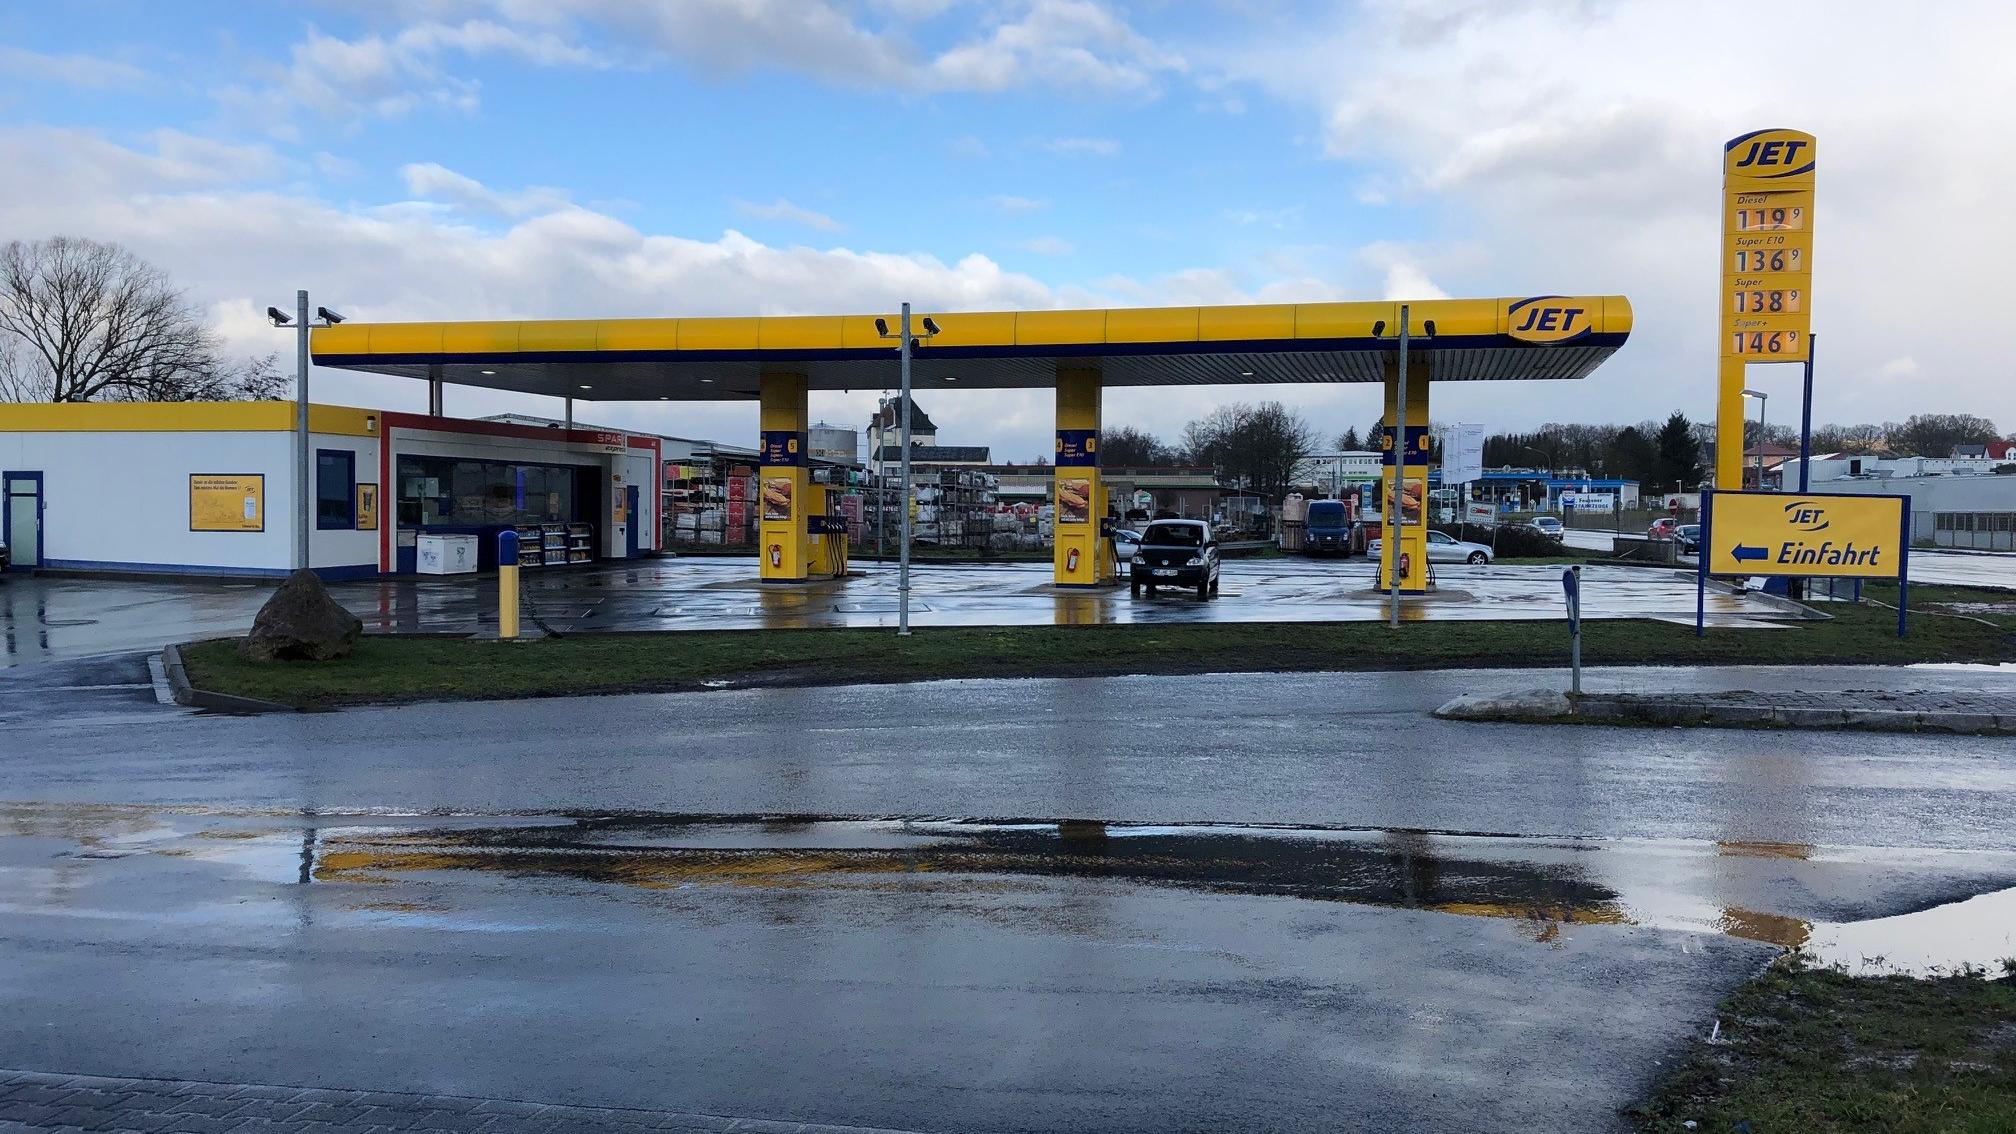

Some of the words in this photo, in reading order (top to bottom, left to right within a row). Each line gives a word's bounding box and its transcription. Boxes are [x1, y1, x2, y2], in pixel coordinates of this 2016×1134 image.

[1736, 141, 1807, 167] JET
[1737, 195, 1768, 205] Diesel
[1736, 237, 1763, 247] Super
[1766, 236, 1785, 245] E10
[1734, 278, 1763, 288] Super
[1516, 308, 1585, 331] JET
[597, 434, 622, 444] SPAR
[1789, 509, 1825, 524] JET
[1776, 541, 1881, 566] Einfahrt
